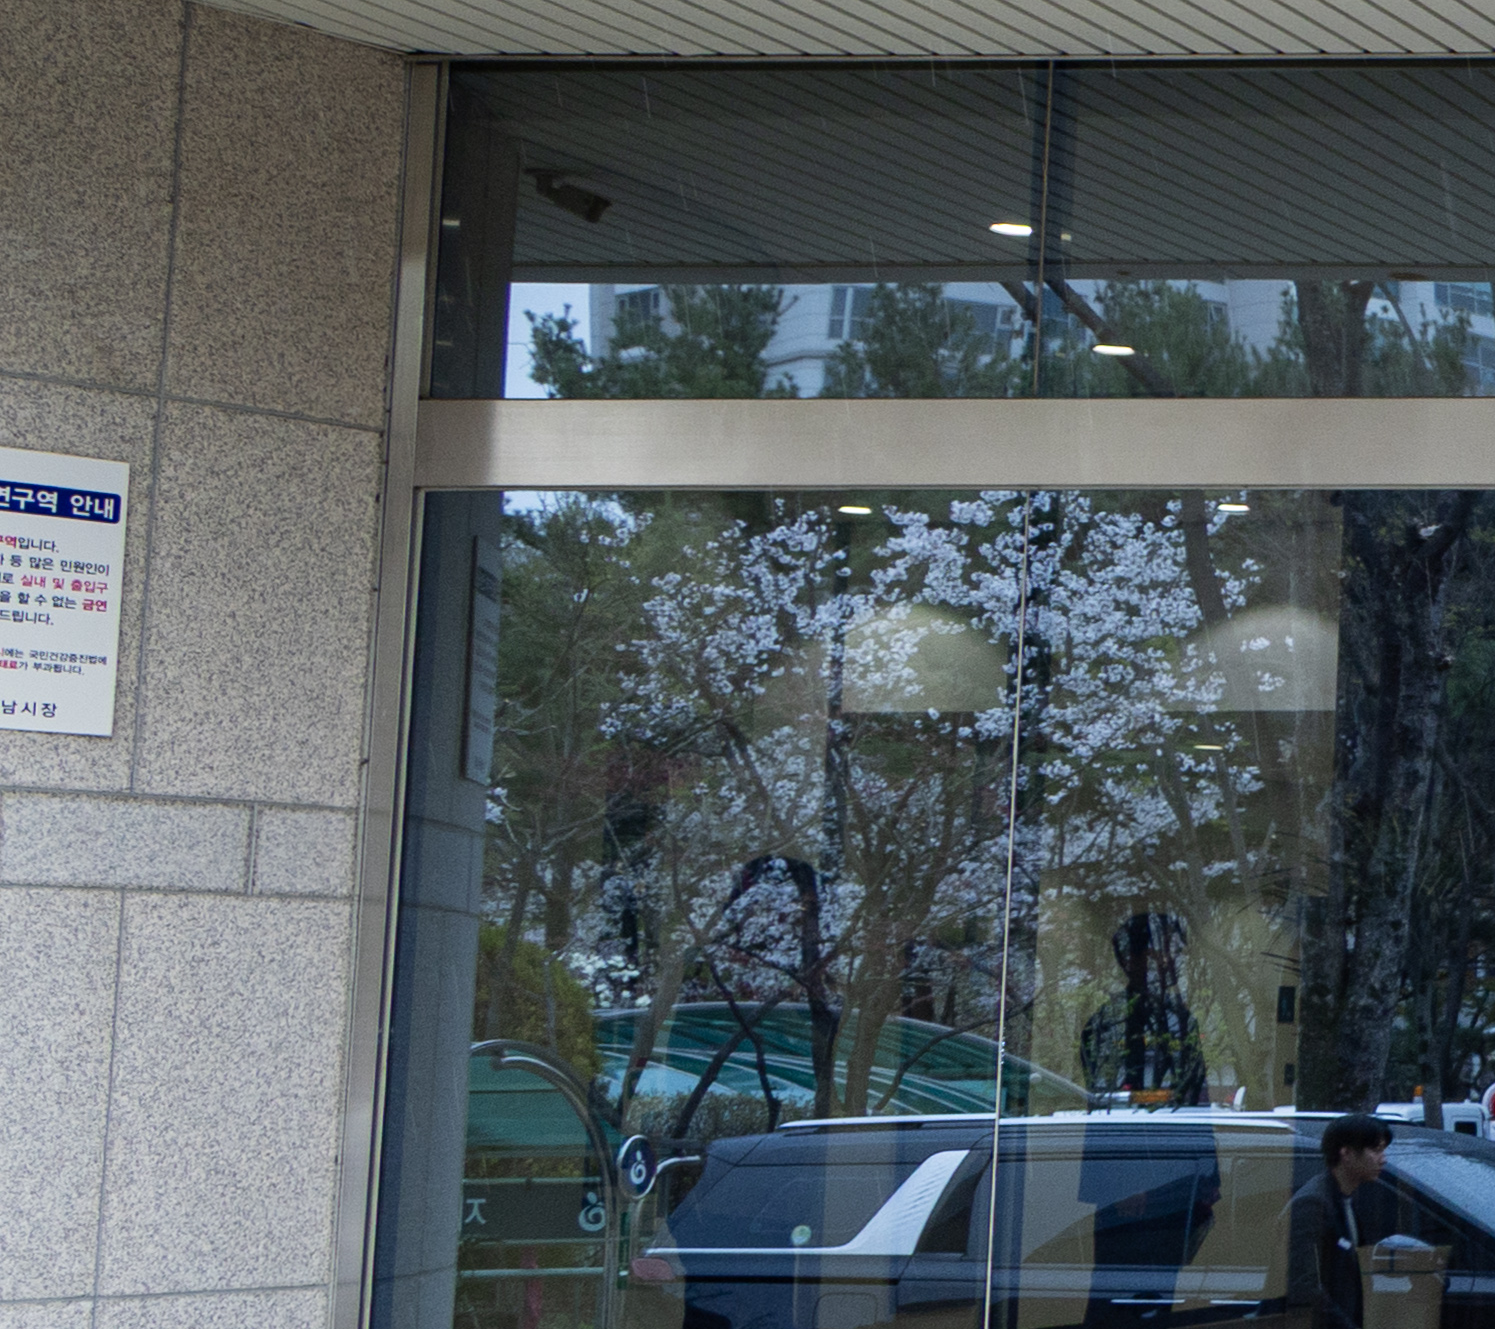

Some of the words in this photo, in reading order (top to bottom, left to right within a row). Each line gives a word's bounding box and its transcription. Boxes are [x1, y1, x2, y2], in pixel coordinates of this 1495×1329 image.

[70, 494, 115, 520] 안내
[0, 534, 59, 554] 역입니다.
[10, 554, 22, 568] 등
[29, 556, 54, 571] 많은
[60, 559, 110, 577] 민원인이
[20, 575, 46, 589] 실내
[52, 577, 65, 591] 및
[71, 578, 108, 594] 출입구
[17, 592, 30, 605] 할
[35, 594, 47, 607] 수
[52, 595, 77, 610] 없는
[82, 598, 107, 613] 금연
